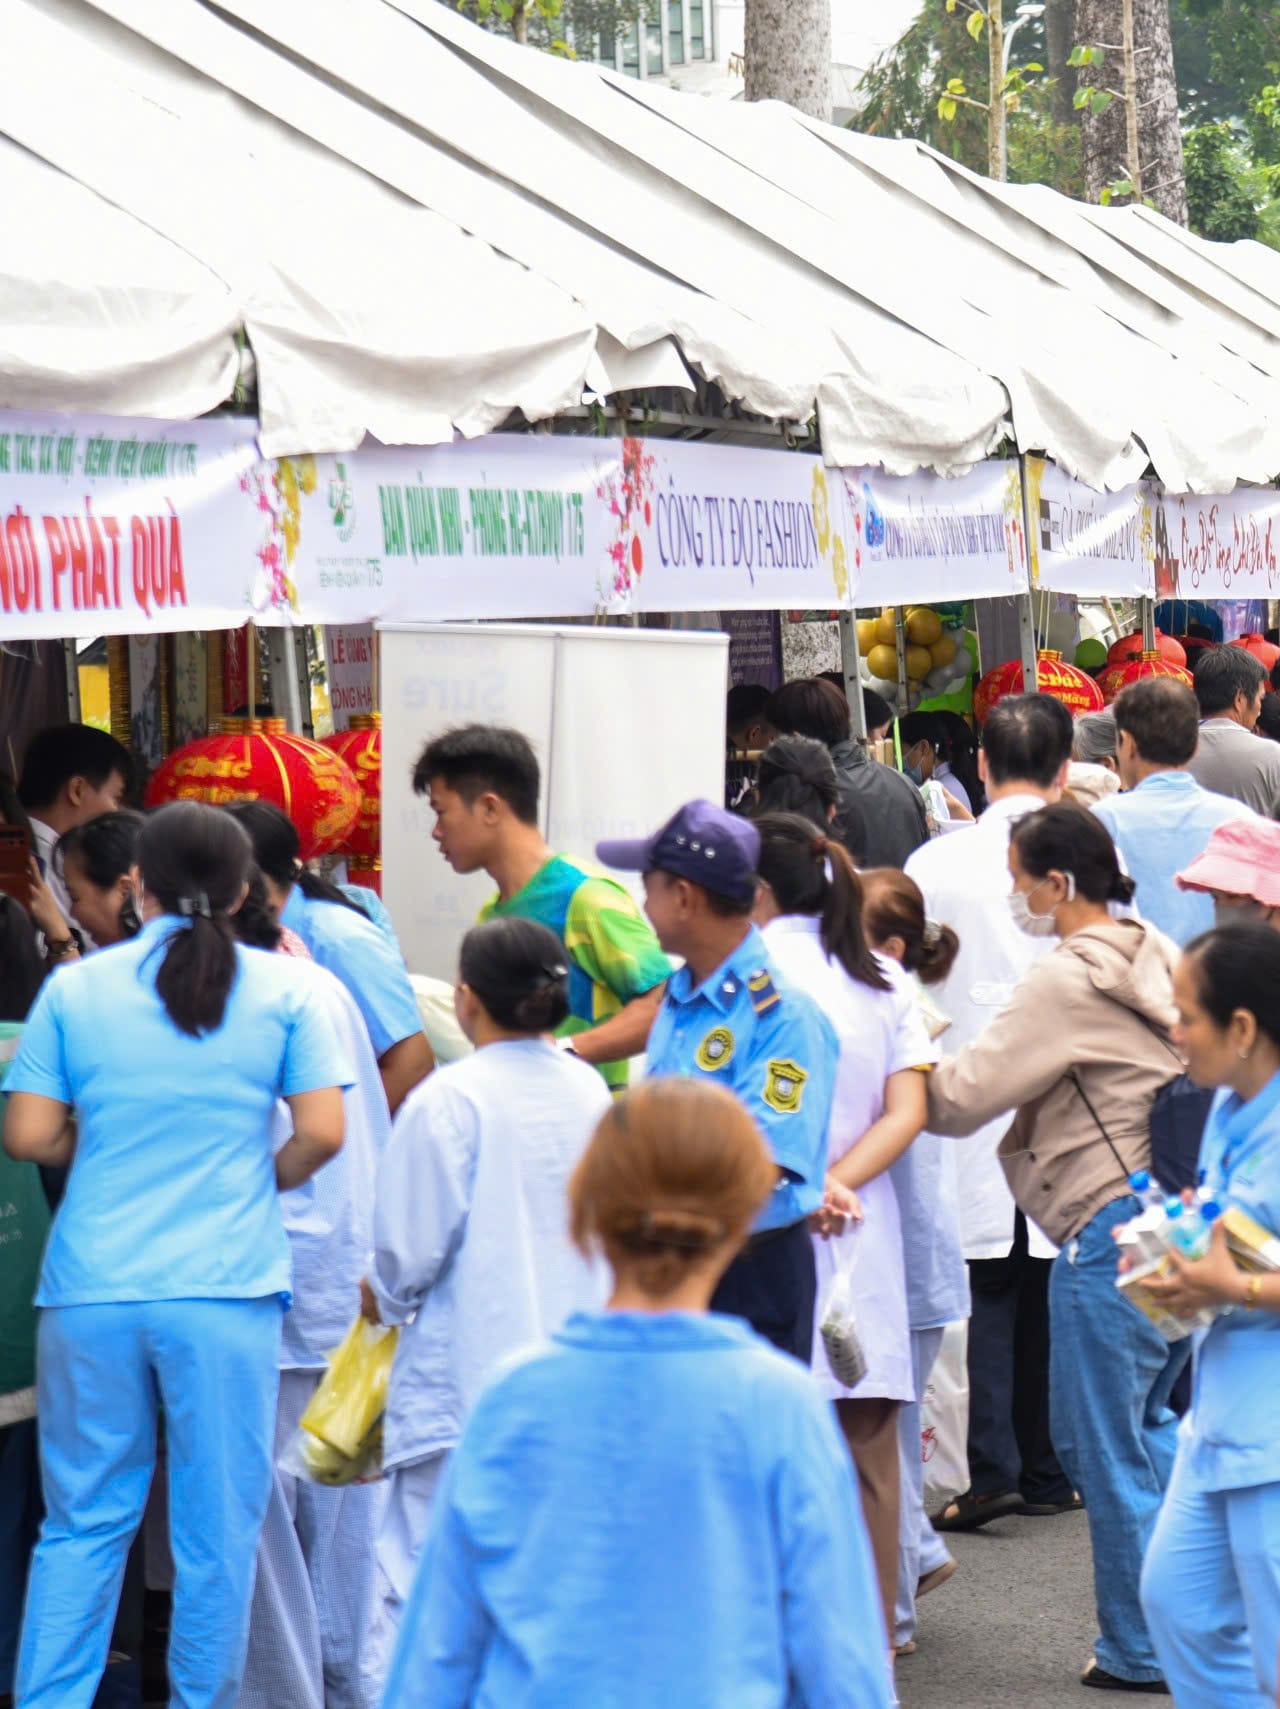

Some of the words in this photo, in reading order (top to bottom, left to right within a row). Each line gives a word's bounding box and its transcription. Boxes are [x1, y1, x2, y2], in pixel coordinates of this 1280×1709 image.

[42, 495, 122, 611] PHÁT
[131, 496, 188, 620] QUÀ
[656, 474, 704, 568] CÔNG
[704, 496, 726, 567] TY
[754, 499, 819, 569] FASHION
